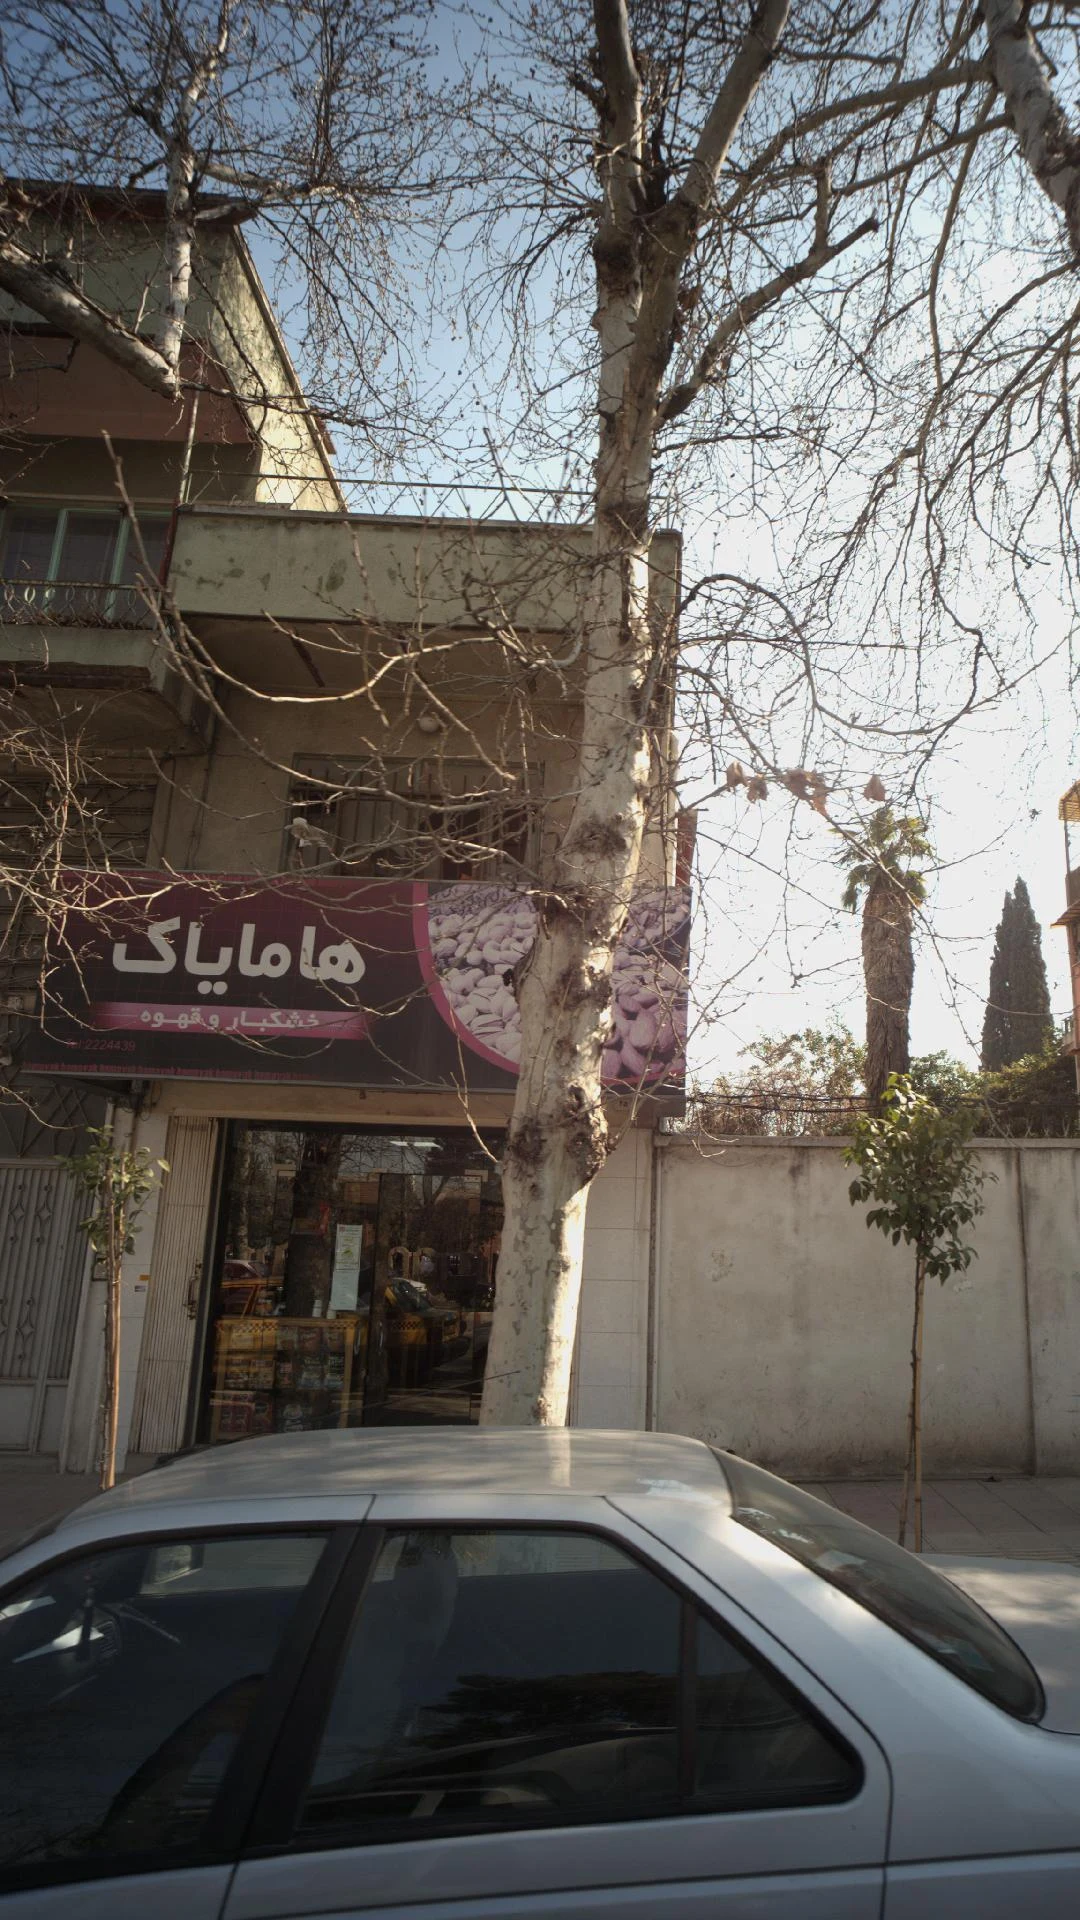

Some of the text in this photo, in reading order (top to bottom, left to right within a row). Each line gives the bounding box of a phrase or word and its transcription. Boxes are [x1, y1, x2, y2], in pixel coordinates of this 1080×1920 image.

[140, 1007, 320, 1032] خشکبار و قهوه
